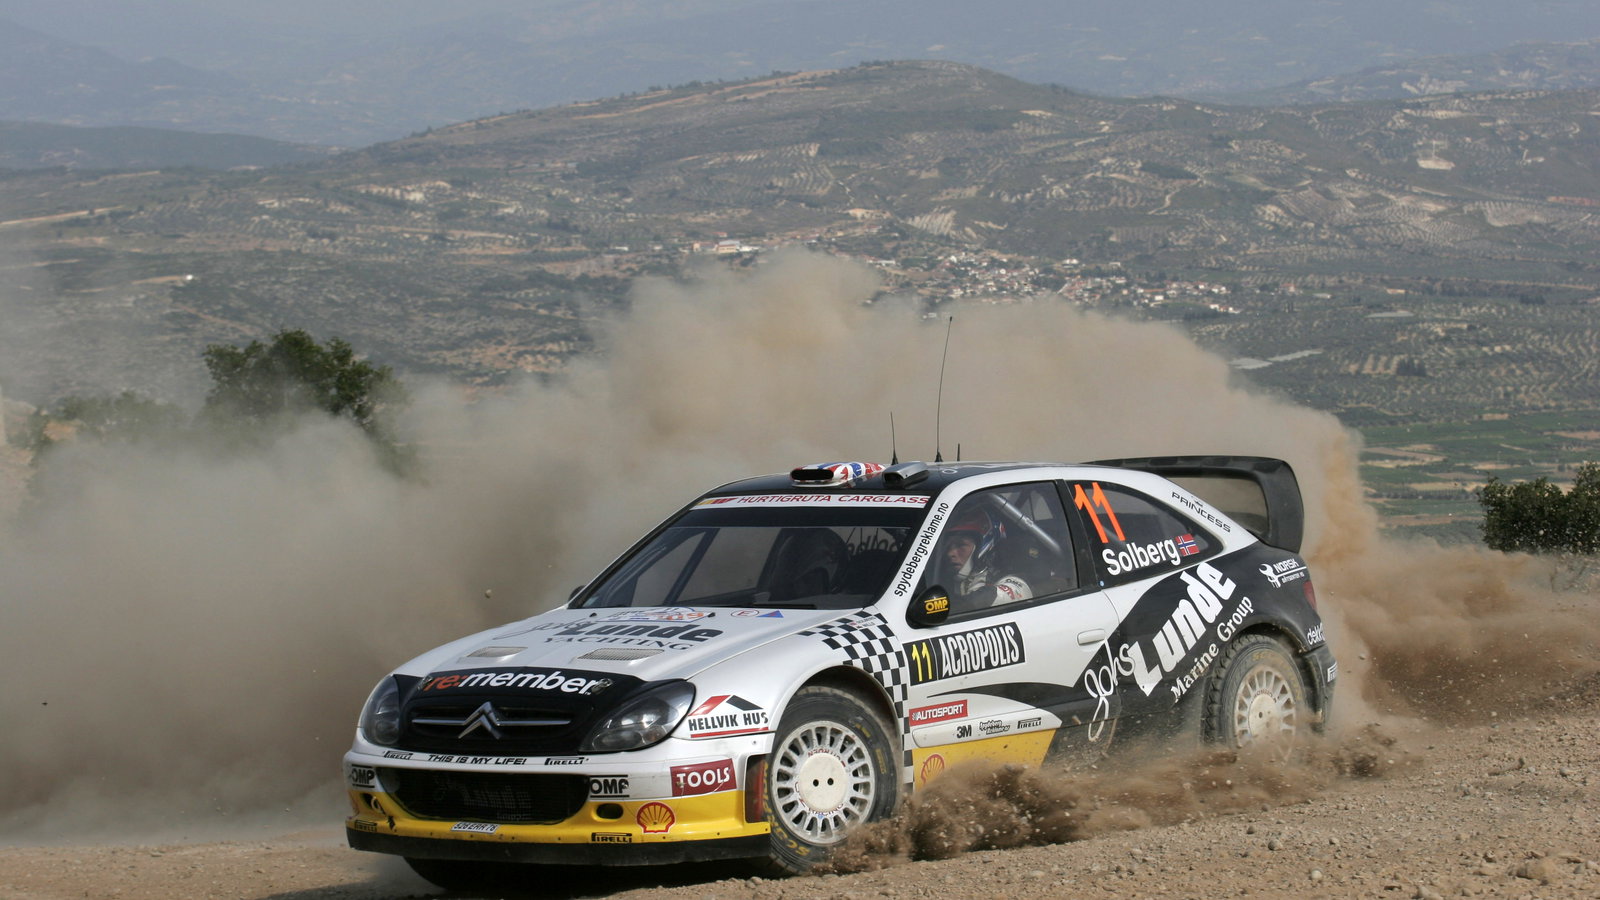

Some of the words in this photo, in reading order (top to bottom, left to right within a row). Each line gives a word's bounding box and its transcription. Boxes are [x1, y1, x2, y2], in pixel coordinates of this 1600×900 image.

[737, 494, 832, 504] HURTIGRUTA
[838, 495, 931, 505] CARGLASS
[1074, 482, 1126, 544] 11
[1171, 491, 1231, 533] PRINCESS
[894, 502, 949, 597] spydebergreklame.no
[1102, 537, 1181, 576] Solberg
[924, 598, 949, 613] OMP
[555, 623, 724, 642] Lunde
[1127, 561, 1237, 697] Lunde
[544, 636, 694, 651] YACHTING
[1170, 643, 1220, 704] Marine
[1216, 596, 1254, 642] Group
[912, 641, 933, 682] 11
[939, 625, 1020, 677] ACROPOLIS
[423, 671, 599, 695] re:member
[914, 703, 964, 721] AUTOSPORT
[688, 714, 739, 732] HELLVIK
[743, 711, 769, 726] HUS
[1017, 717, 1042, 729] PIRELLI
[956, 724, 972, 739] 3M
[384, 750, 414, 761] PIRELLI
[428, 754, 454, 762] THIS
[470, 757, 493, 765] MY
[494, 757, 528, 765] LIFE!
[544, 756, 586, 766] PIRELLI
[351, 767, 376, 785] OMP
[676, 766, 731, 788] TOOLS
[589, 779, 630, 795] OMP
[591, 832, 633, 843] PIRELLI
